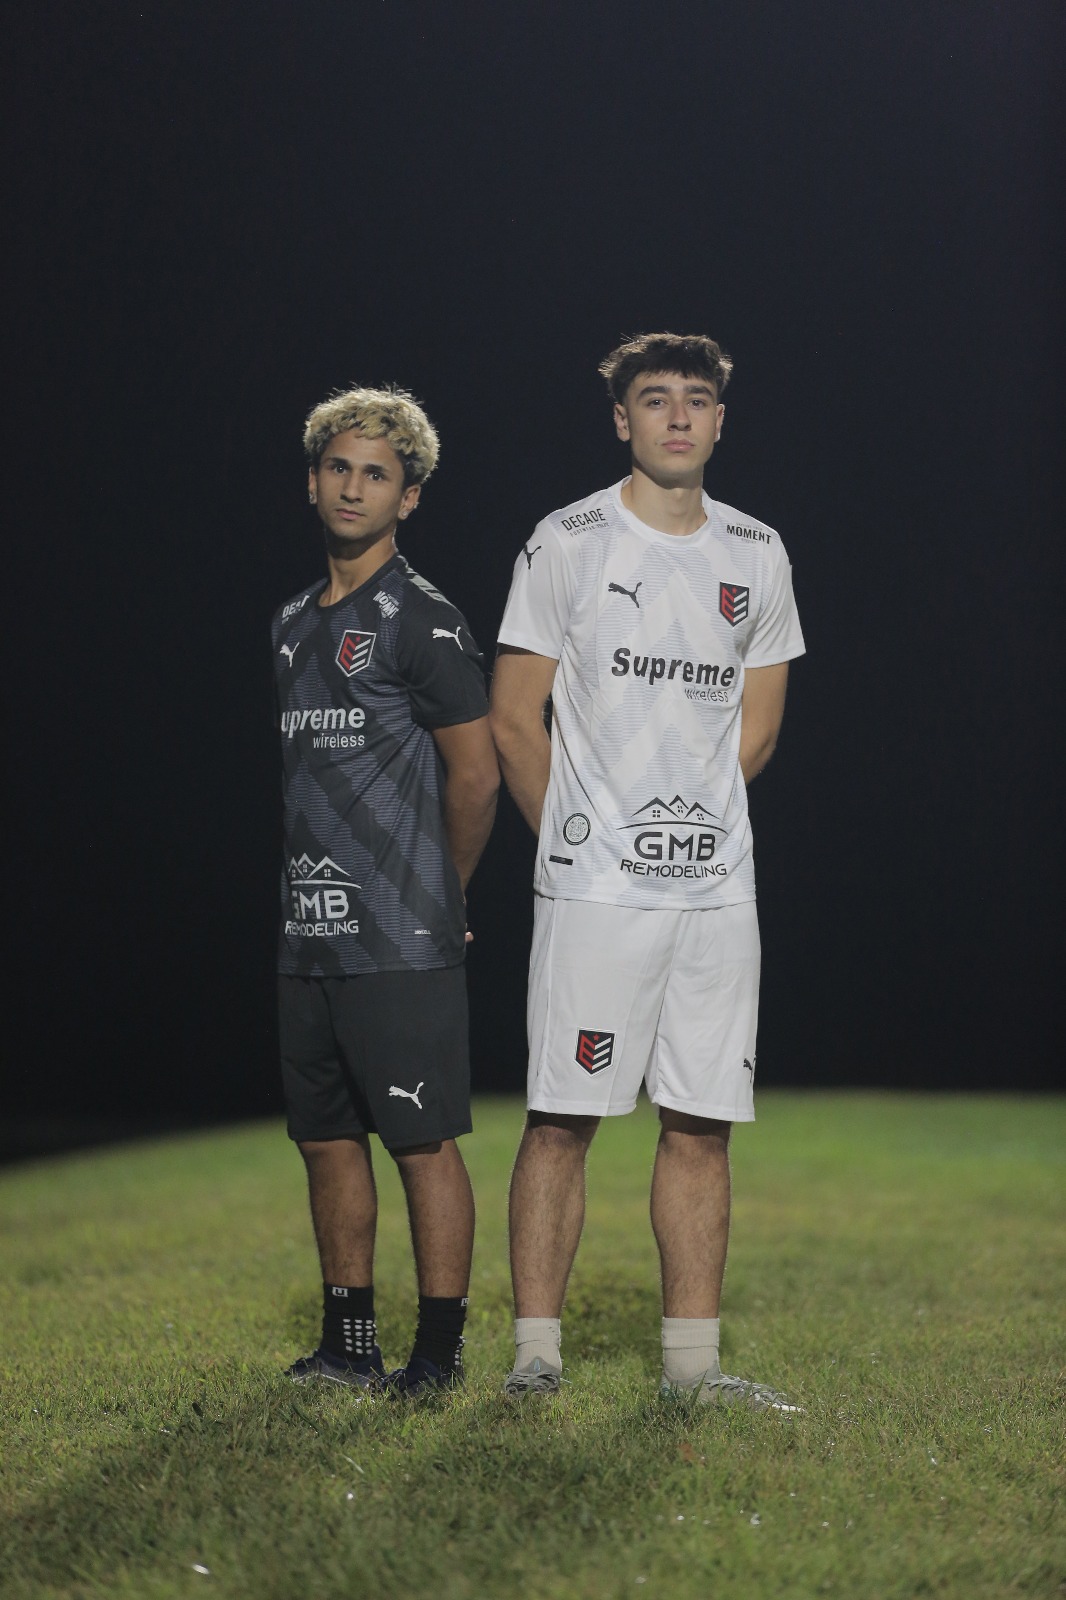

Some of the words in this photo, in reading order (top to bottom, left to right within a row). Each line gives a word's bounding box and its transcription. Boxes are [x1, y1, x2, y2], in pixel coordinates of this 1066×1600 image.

[561, 508, 606, 531] DECADE
[726, 524, 772, 545] MOMENT
[611, 647, 735, 687] Supreme
[684, 686, 730, 703] wireless
[313, 733, 365, 749] wireless
[633, 831, 716, 861] GMB
[620, 858, 727, 878] REMODELING
[284, 920, 360, 938] REMODELING
